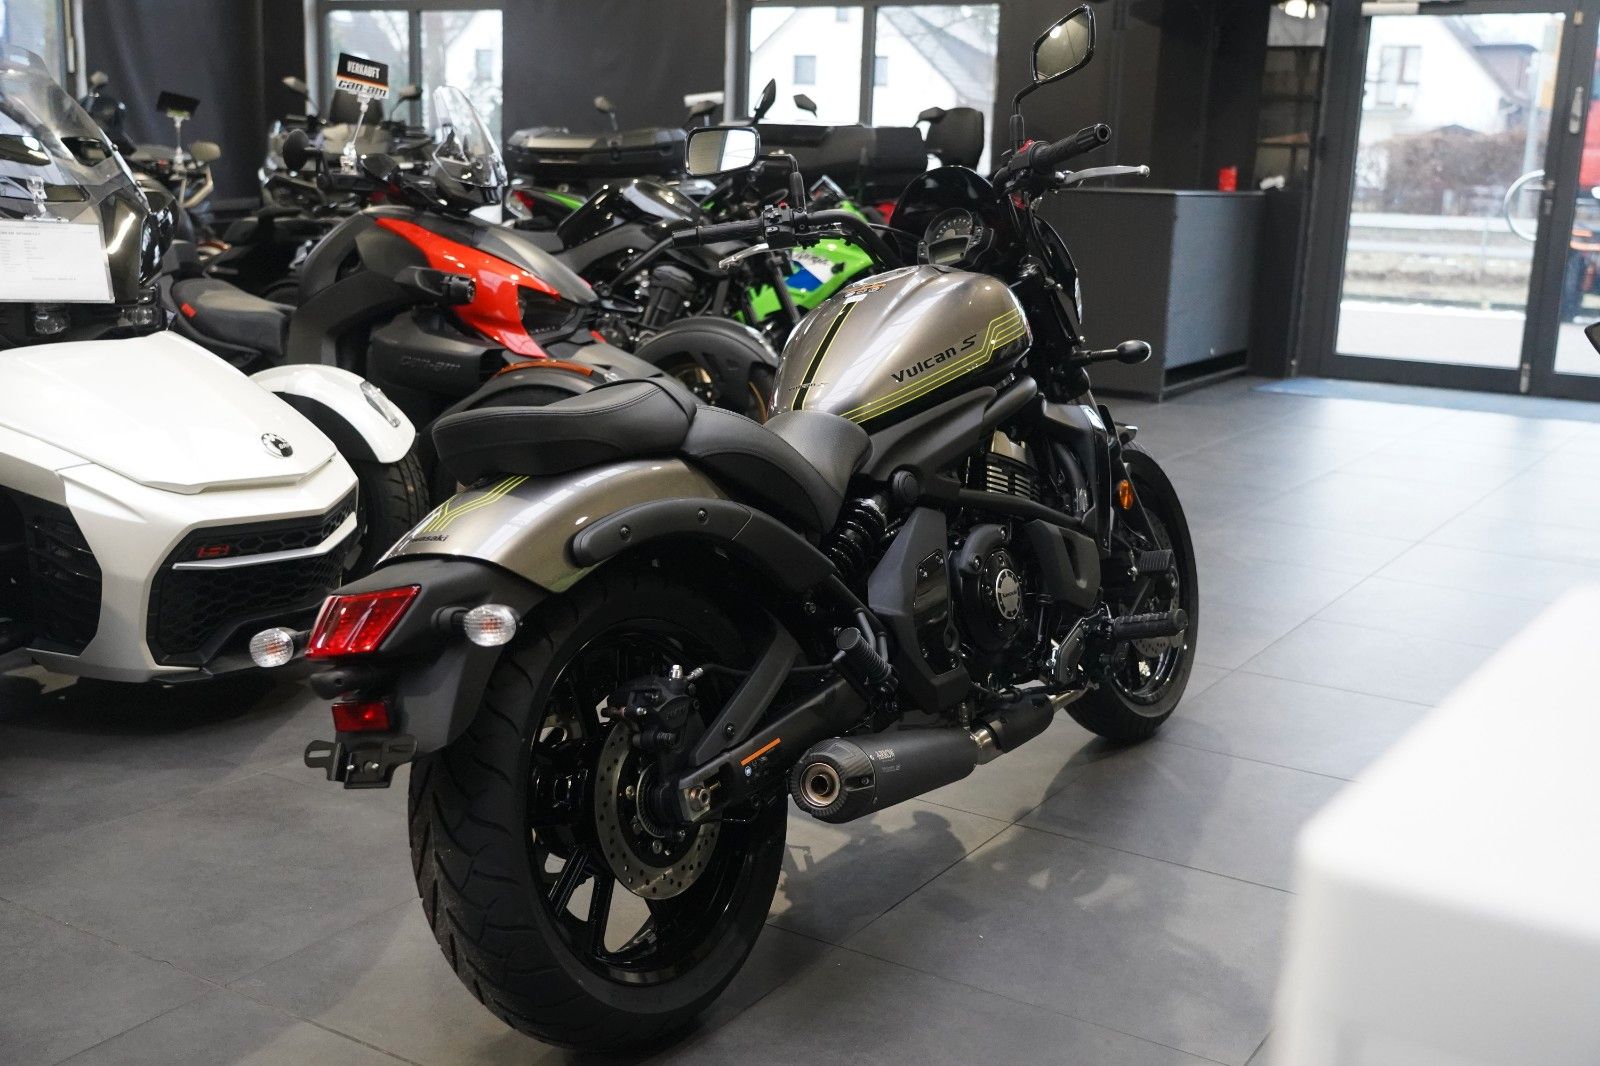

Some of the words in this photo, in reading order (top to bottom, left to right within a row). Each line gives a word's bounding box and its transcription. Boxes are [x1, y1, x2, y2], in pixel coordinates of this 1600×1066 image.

[346, 60, 380, 79] VERKAUFT
[338, 80, 387, 97] can-am
[890, 347, 957, 383] Vulcan
[960, 334, 977, 351] S
